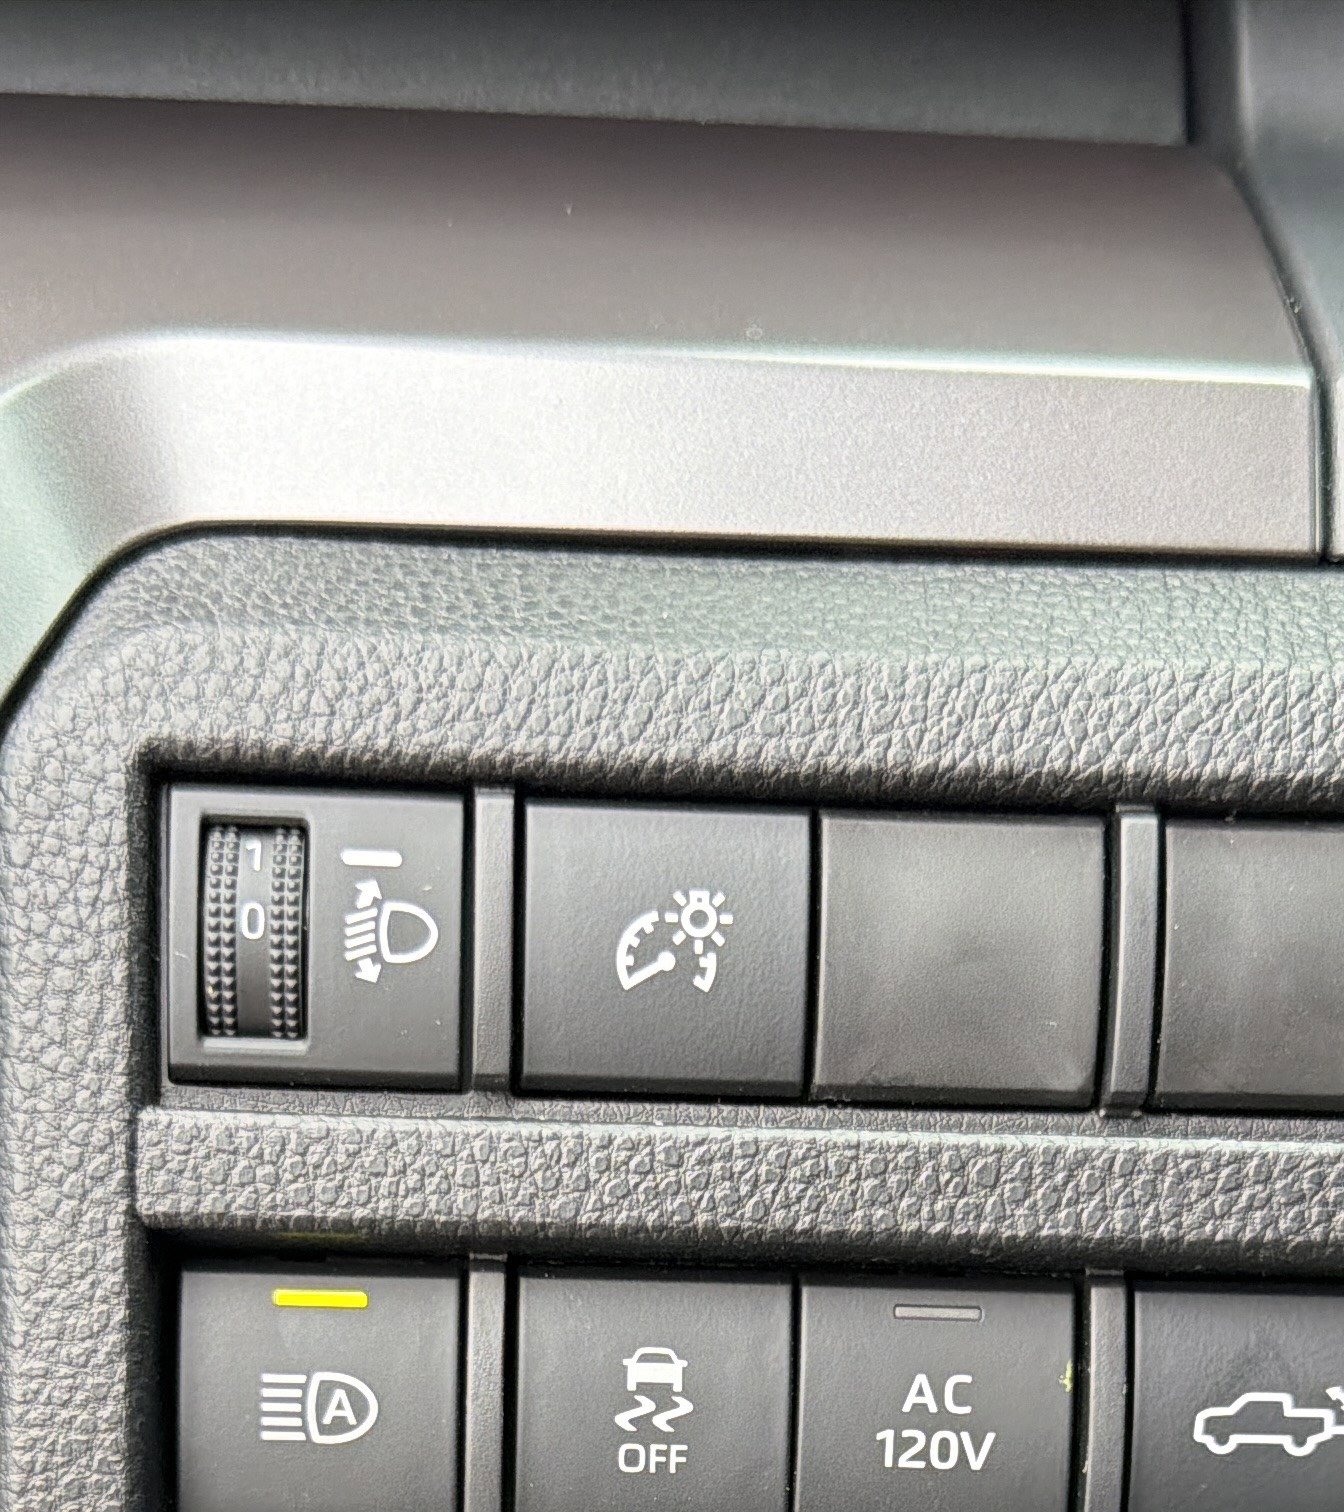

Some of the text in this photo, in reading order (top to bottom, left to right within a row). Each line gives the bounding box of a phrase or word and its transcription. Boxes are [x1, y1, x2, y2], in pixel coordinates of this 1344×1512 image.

[245, 839, 262, 873] 1
[240, 901, 266, 940] 0
[321, 1387, 358, 1426] A
[901, 1373, 974, 1416] AC
[616, 1441, 689, 1475] OFF
[875, 1428, 997, 1472] 120V
